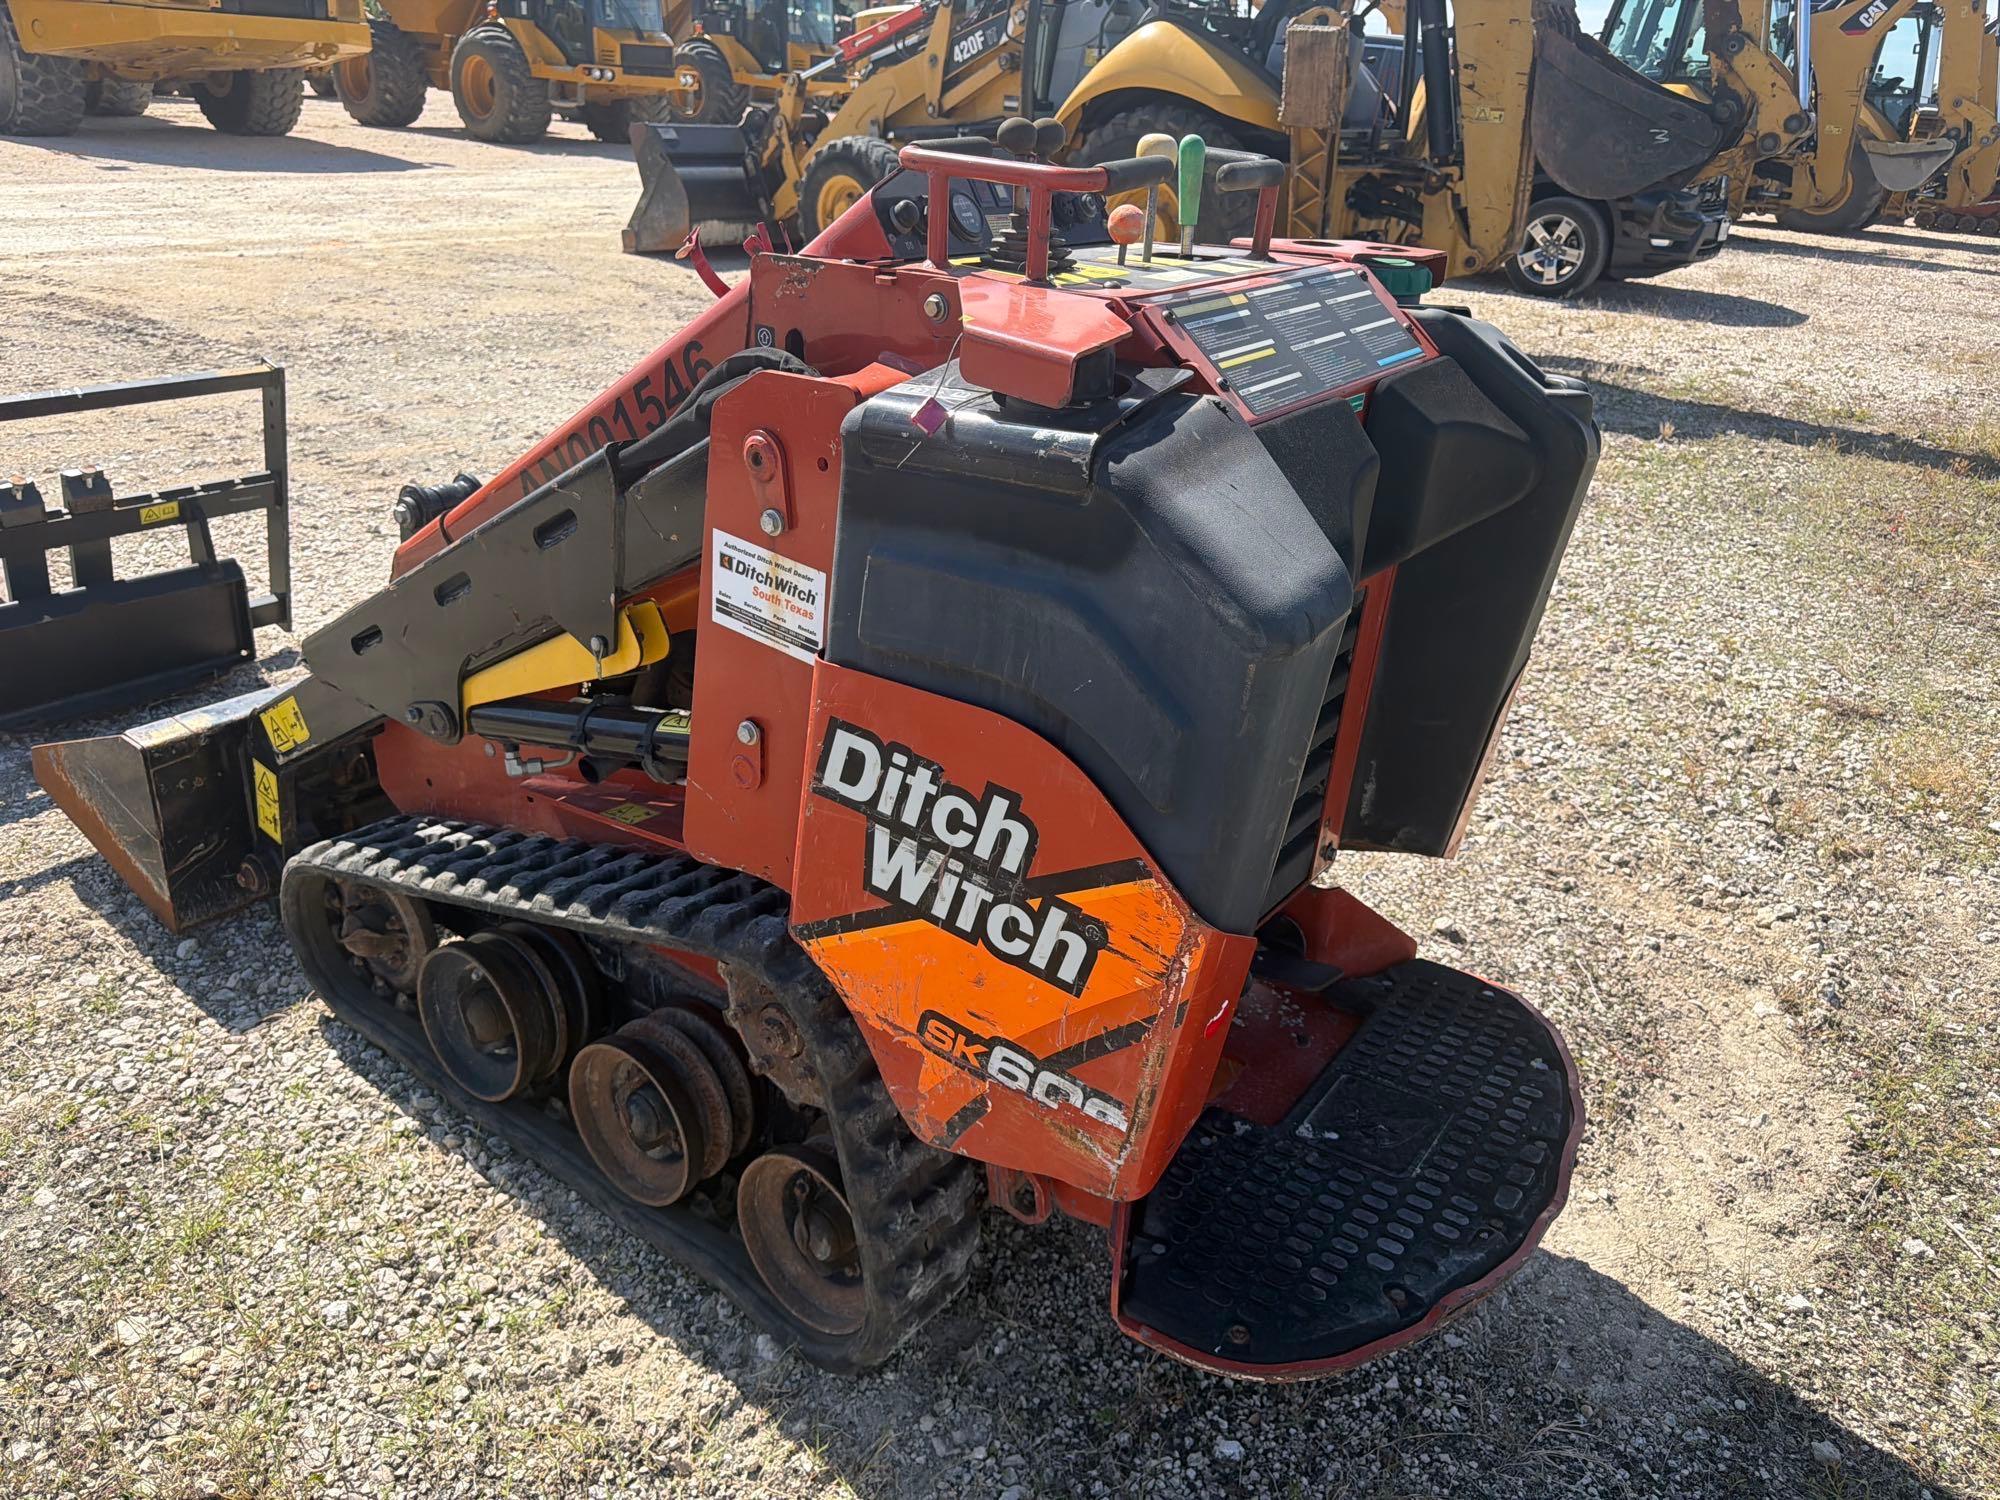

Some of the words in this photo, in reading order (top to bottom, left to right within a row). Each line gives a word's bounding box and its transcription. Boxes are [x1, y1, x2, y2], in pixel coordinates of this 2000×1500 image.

[1859, 0, 1889, 28] CAT
[953, 30, 984, 62] 420F
[723, 541, 756, 560] Authorized
[756, 554, 773, 567] Ditch
[793, 570, 815, 583] Dealer
[752, 585, 781, 607] South
[784, 598, 815, 621] Texas
[822, 728, 1029, 874] Ditch
[871, 823, 1088, 984] Witch
